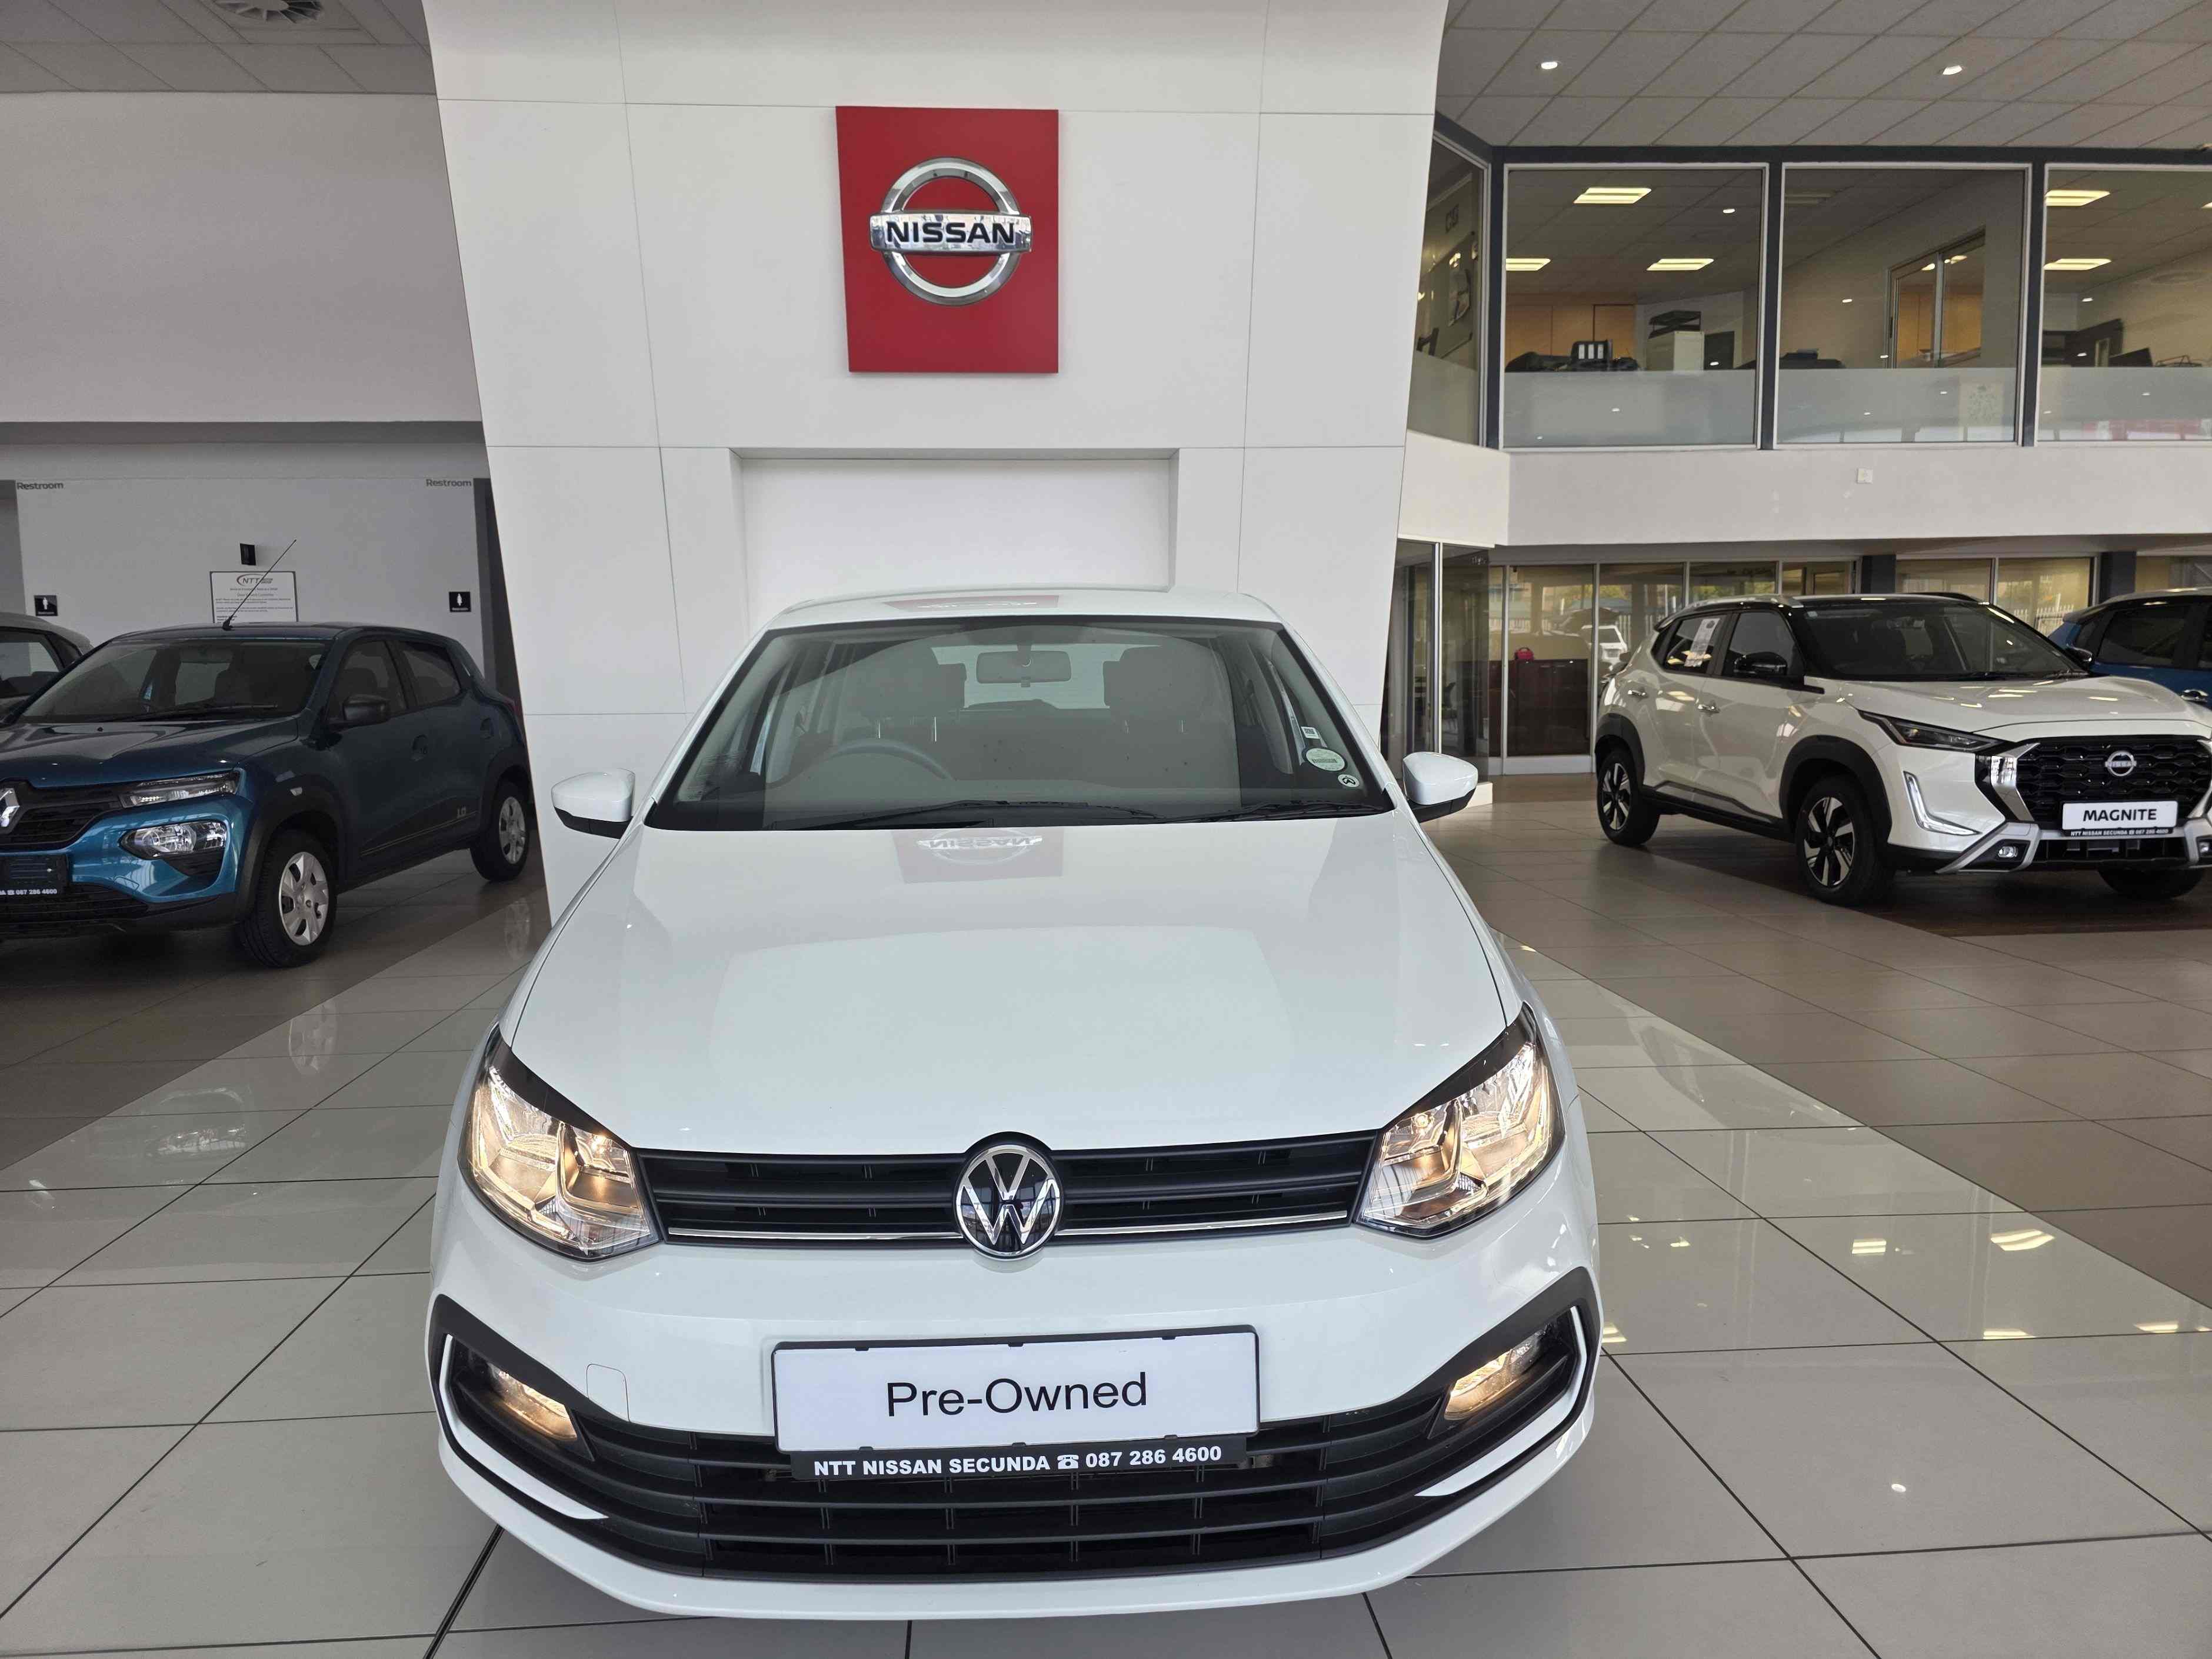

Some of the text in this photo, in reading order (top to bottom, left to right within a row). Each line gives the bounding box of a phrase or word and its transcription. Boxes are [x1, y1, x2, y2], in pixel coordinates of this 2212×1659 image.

[887, 221, 1015, 244] NISSAN
[16, 482, 64, 490] Restroom
[425, 478, 472, 488] Restroom
[2083, 808, 2157, 822] MAGNITE
[887, 1371, 1147, 1417] Pre-Owned
[814, 1445, 1222, 1477] NTT NISSAN SECUNDA 087 286 4600
